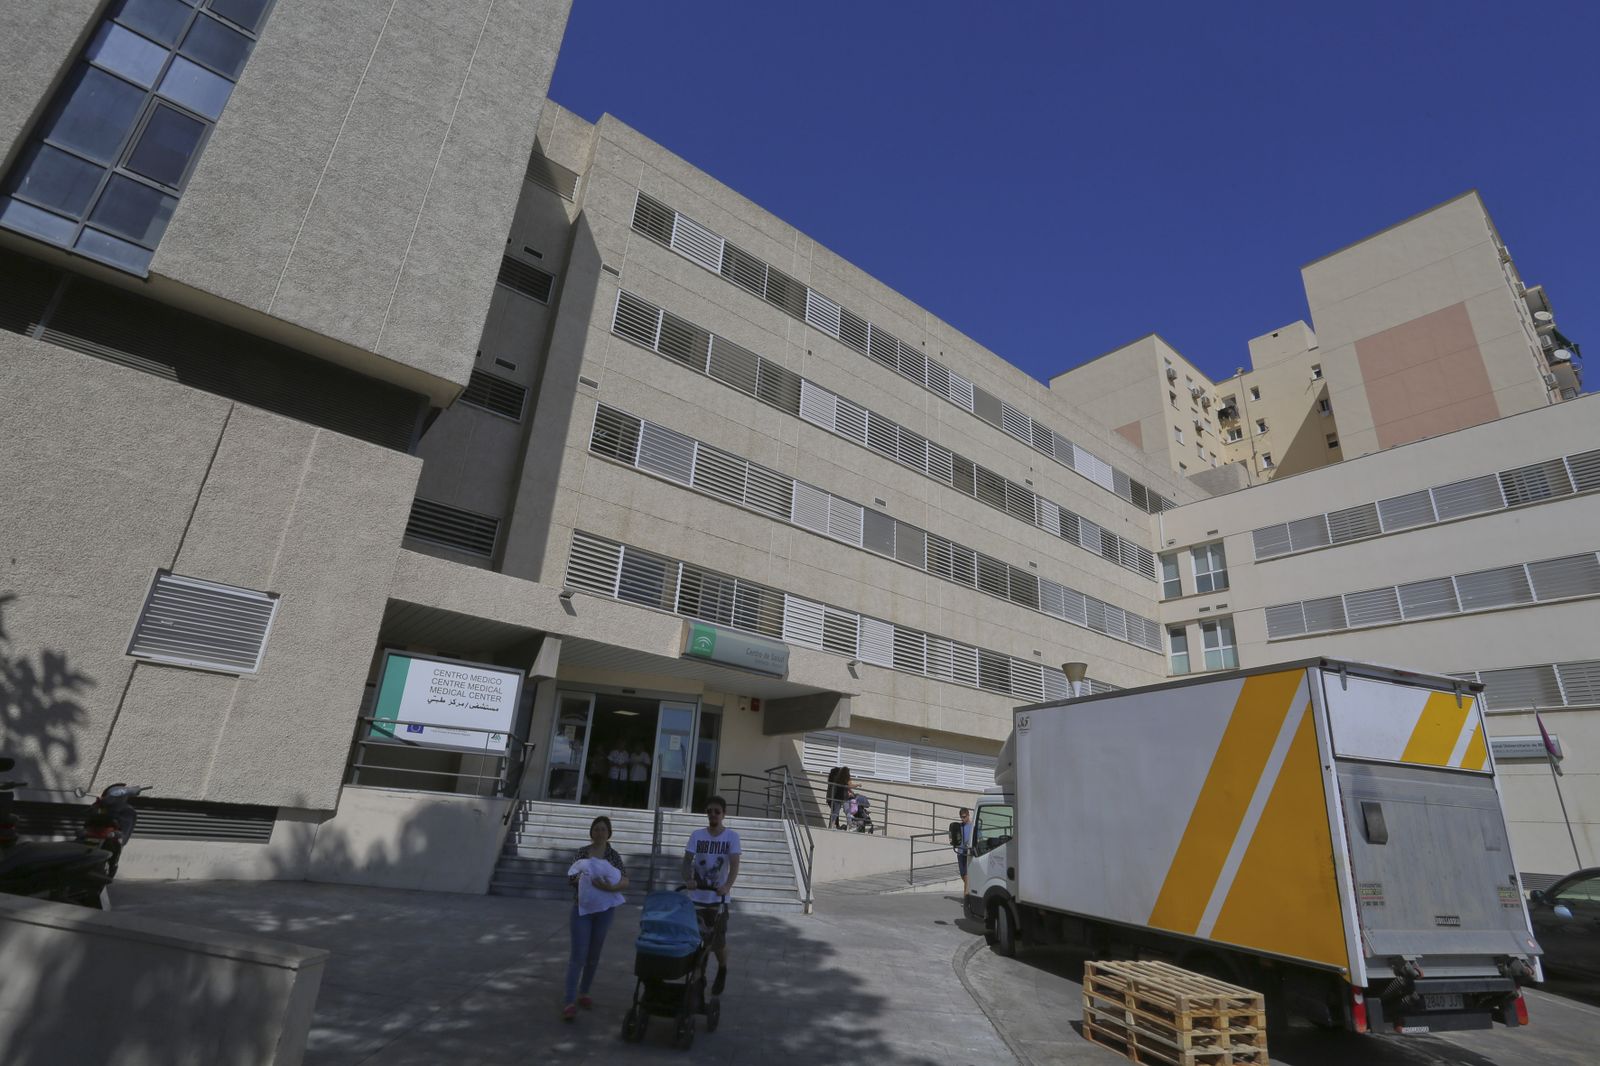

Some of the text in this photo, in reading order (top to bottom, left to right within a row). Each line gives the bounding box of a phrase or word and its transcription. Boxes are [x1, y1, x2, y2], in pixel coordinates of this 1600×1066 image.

[433, 669, 502, 686] CENTRO MEDICO
[429, 686, 502, 704] MEDICAL CENTER
[431, 678, 503, 695] CENTRE MEDICAL
[697, 840, 730, 854] BOB DYLAN
